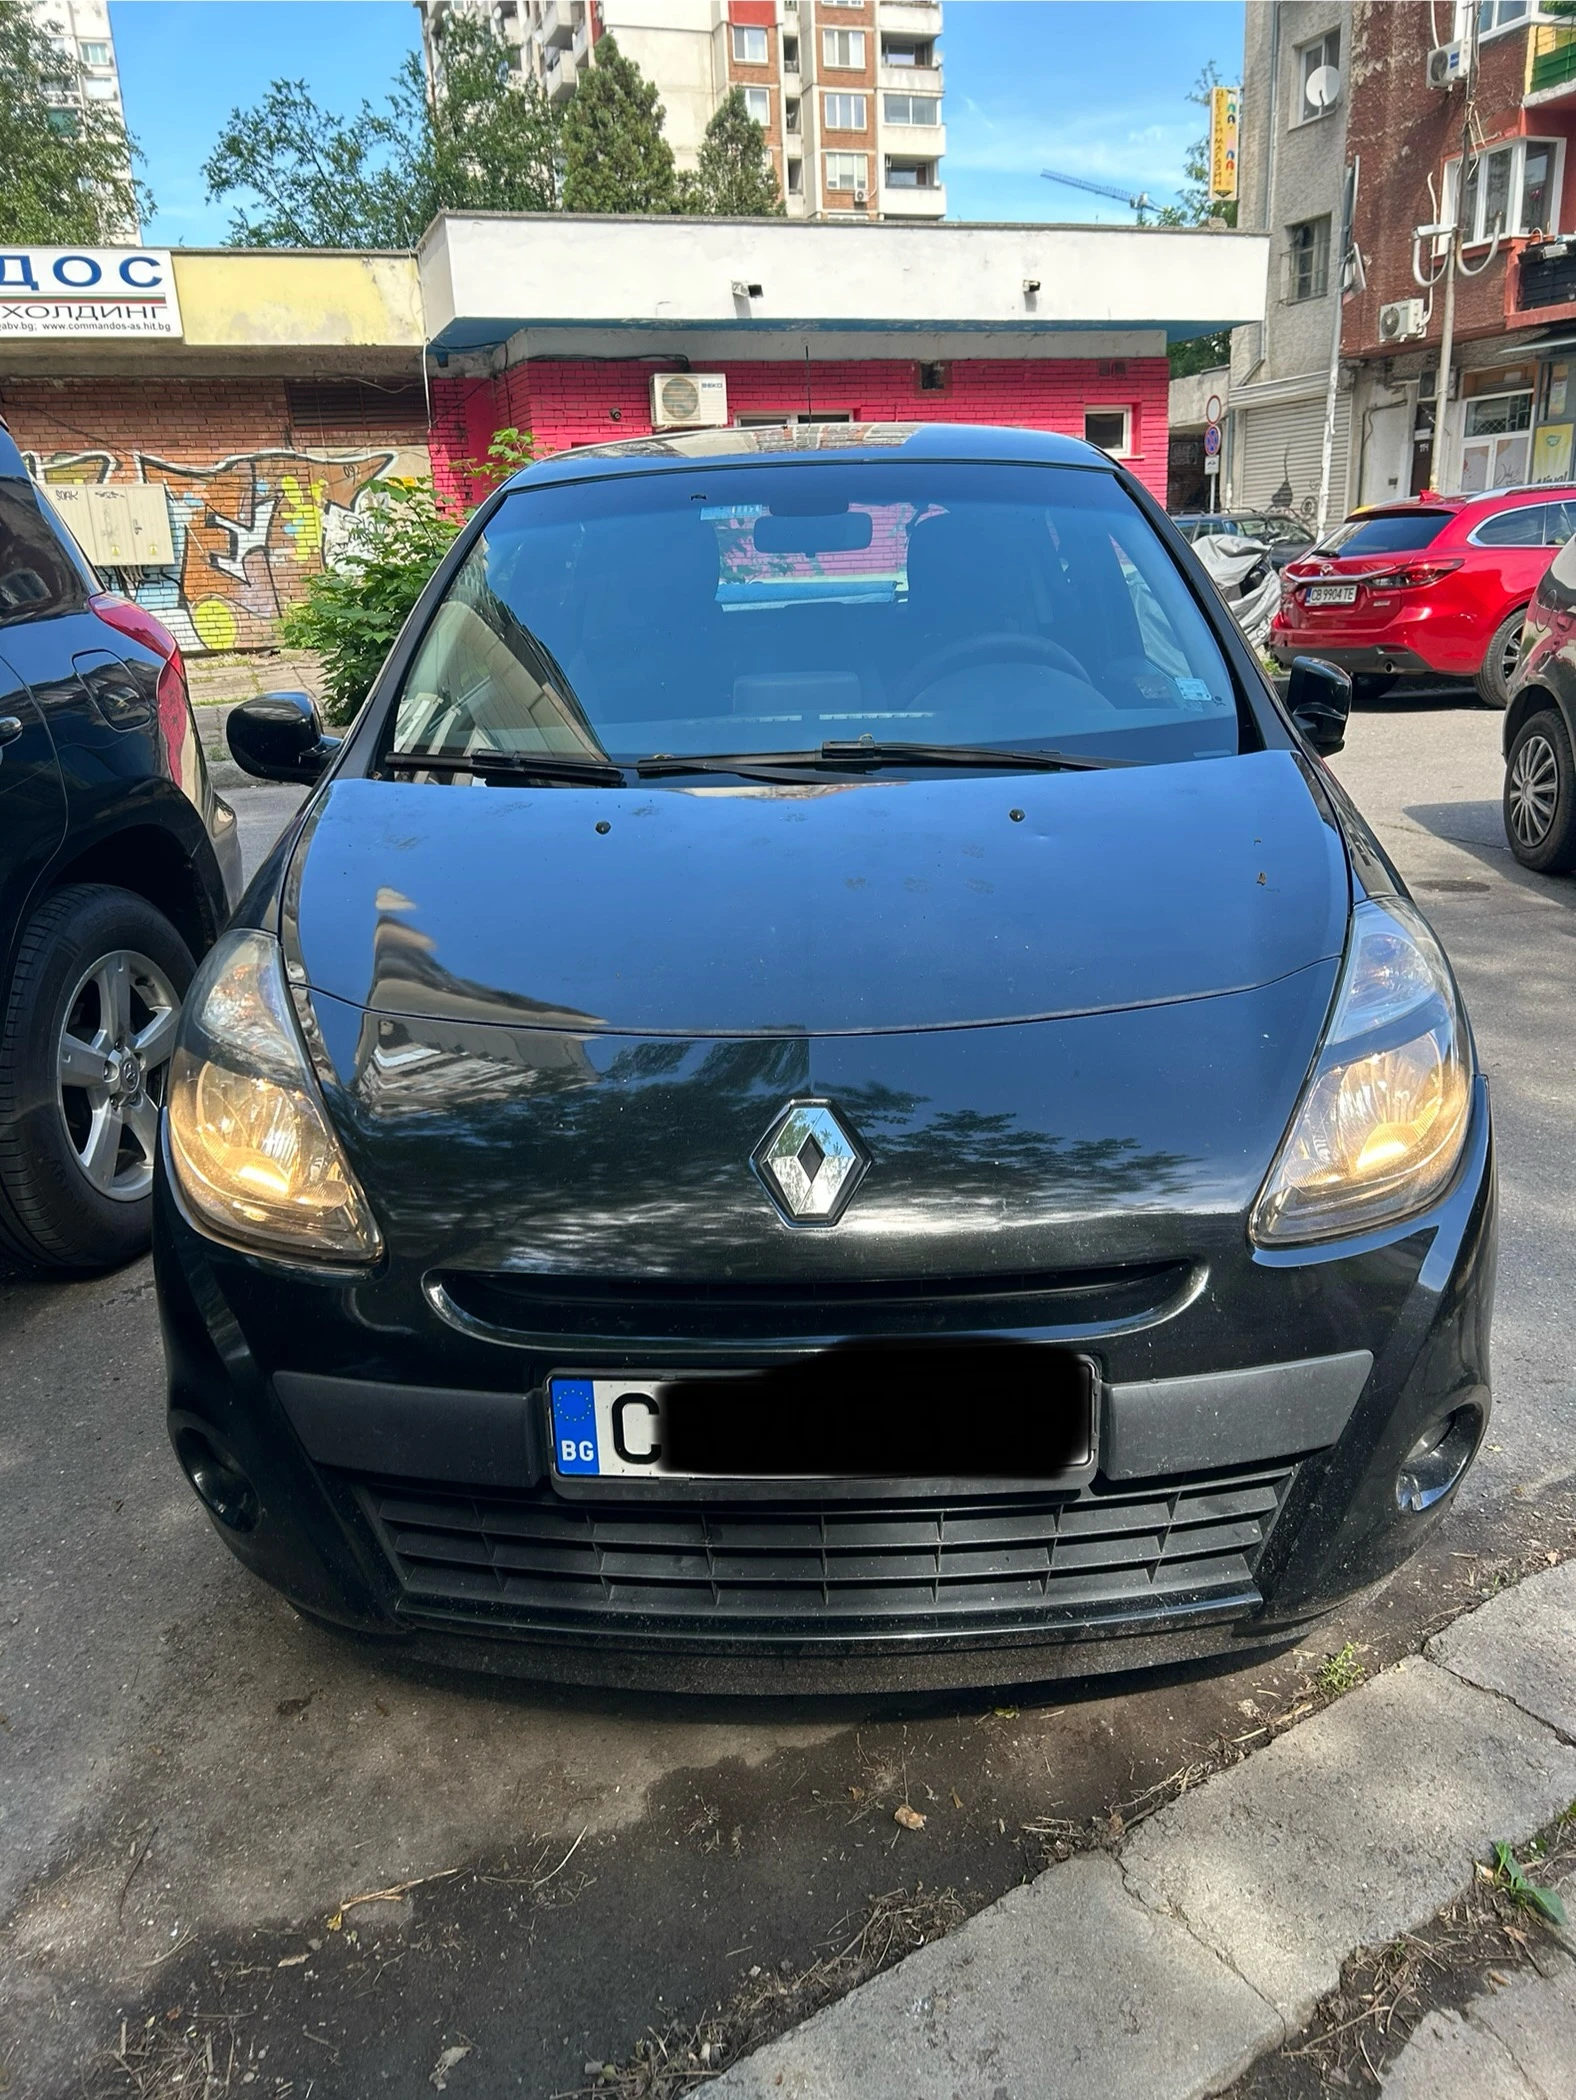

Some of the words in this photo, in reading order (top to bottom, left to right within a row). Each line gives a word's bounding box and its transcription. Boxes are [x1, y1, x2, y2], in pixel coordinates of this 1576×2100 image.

[0, 255, 163, 291] ДОС
[2, 305, 168, 321] ХОЛДИНГ
[0, 320, 38, 332] abv.bg;
[42, 322, 171, 332] www.commandos-as.hit.bg
[561, 1440, 594, 1462] BG
